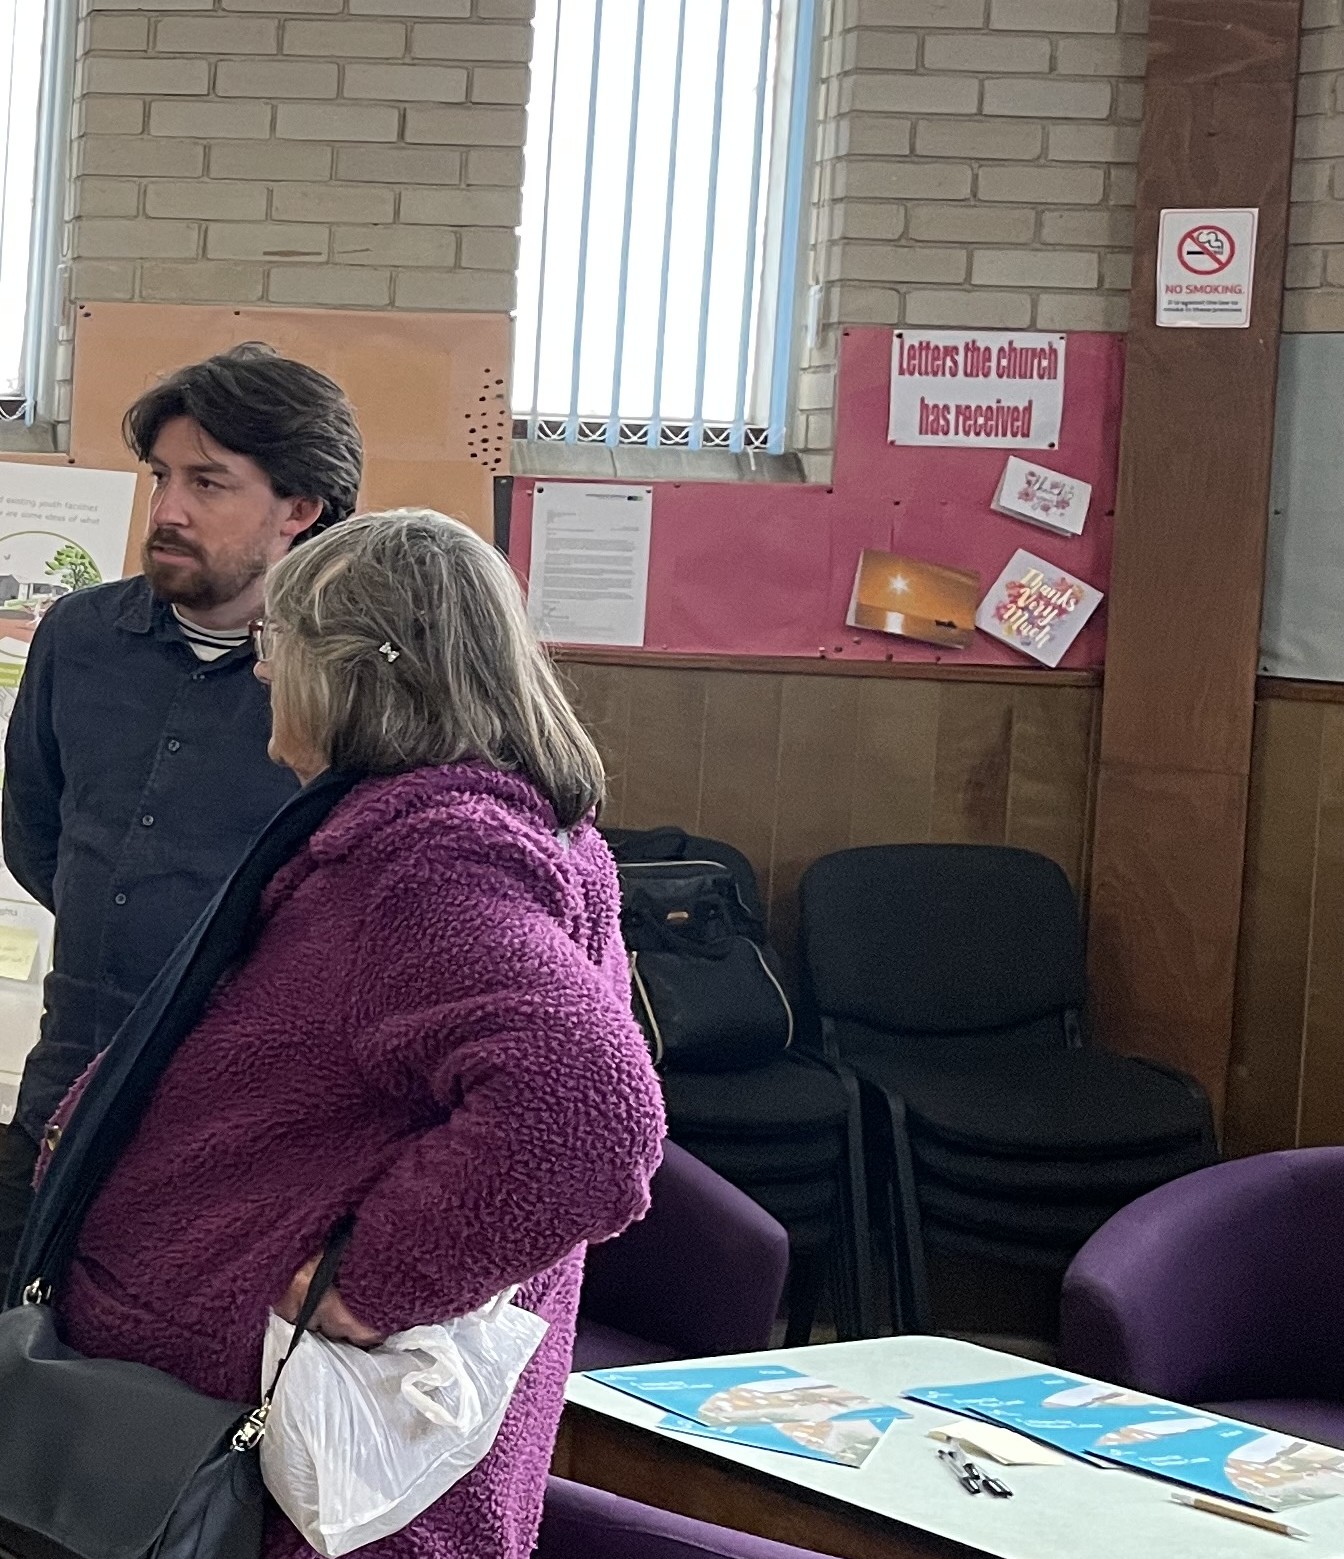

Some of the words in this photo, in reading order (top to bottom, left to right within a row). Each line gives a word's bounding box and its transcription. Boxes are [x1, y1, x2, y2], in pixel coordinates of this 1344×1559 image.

[1165, 284, 1183, 294] NO
[898, 338, 959, 378] Letters
[964, 339, 992, 378] the
[996, 340, 1058, 380] church
[919, 396, 950, 436] has
[954, 399, 1032, 438] received
[1017, 587, 1058, 626] Very
[1020, 567, 1075, 612] Thanks
[1003, 603, 1050, 649] Much
